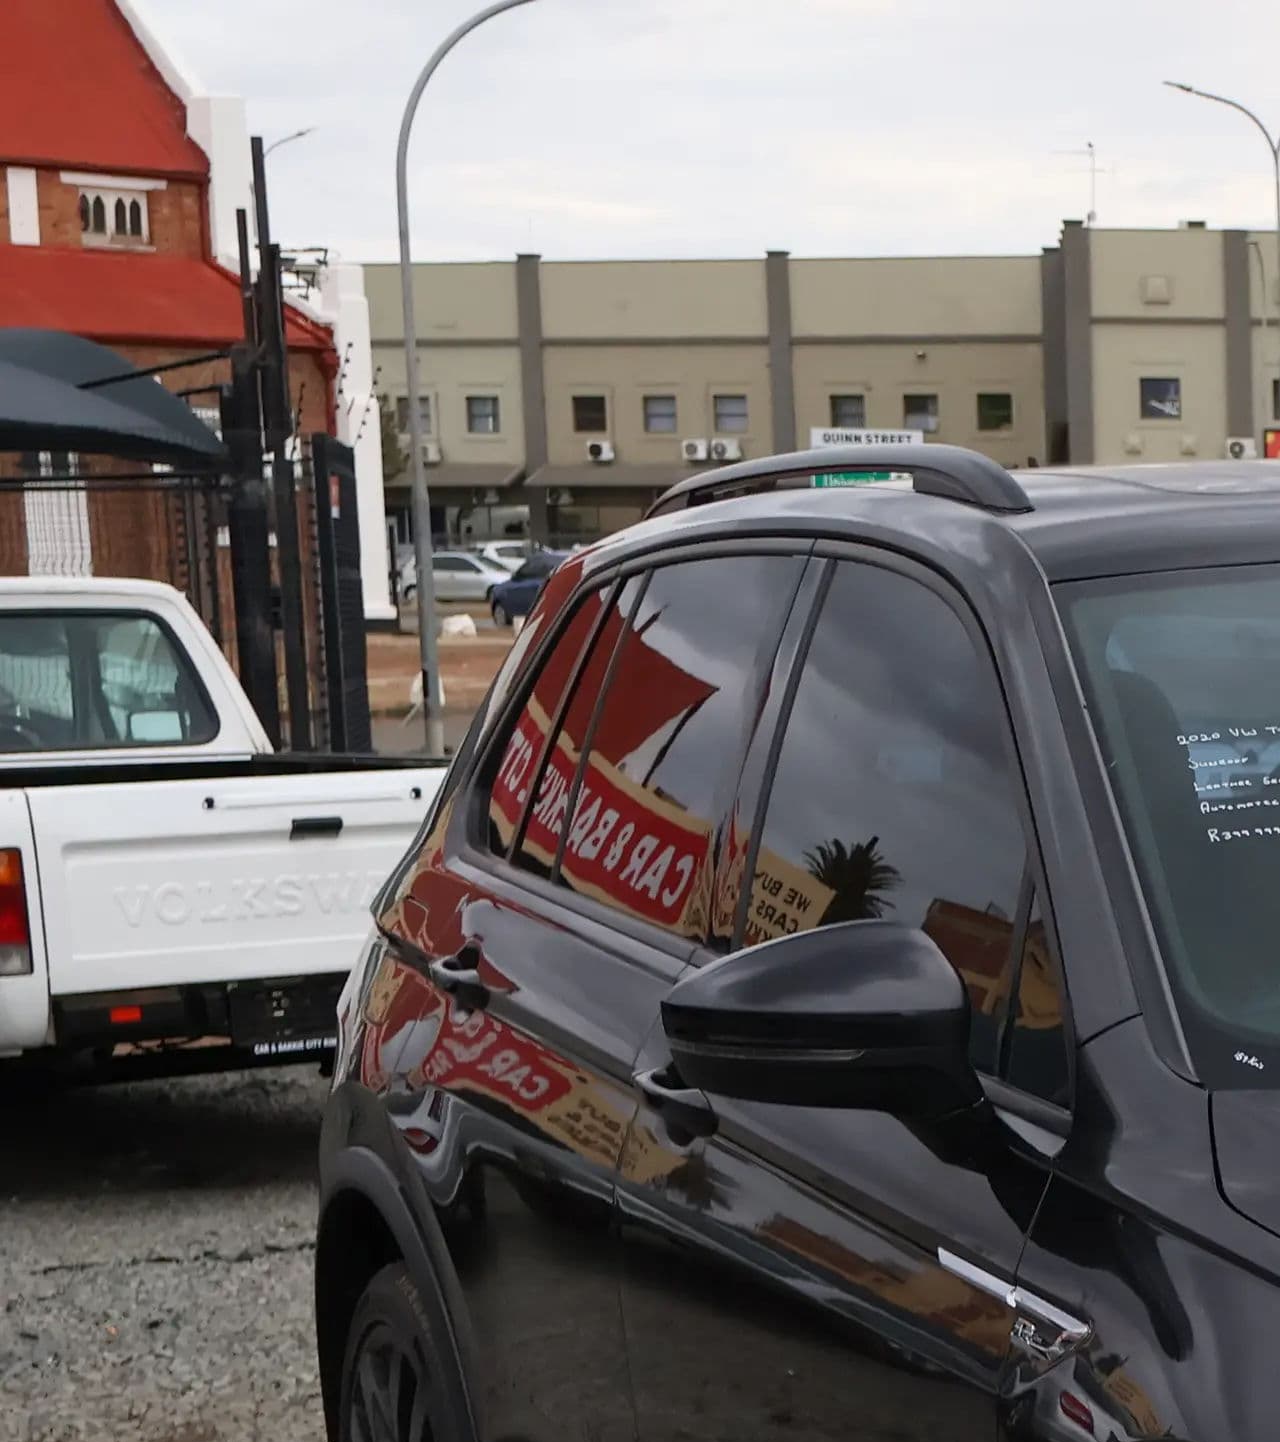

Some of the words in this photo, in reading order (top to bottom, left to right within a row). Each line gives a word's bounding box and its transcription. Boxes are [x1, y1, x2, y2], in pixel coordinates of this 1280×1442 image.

[822, 433, 862, 444] QUINN
[865, 433, 912, 445] STREET
[1177, 732, 1221, 745] 2020
[1229, 727, 1257, 736] VW
